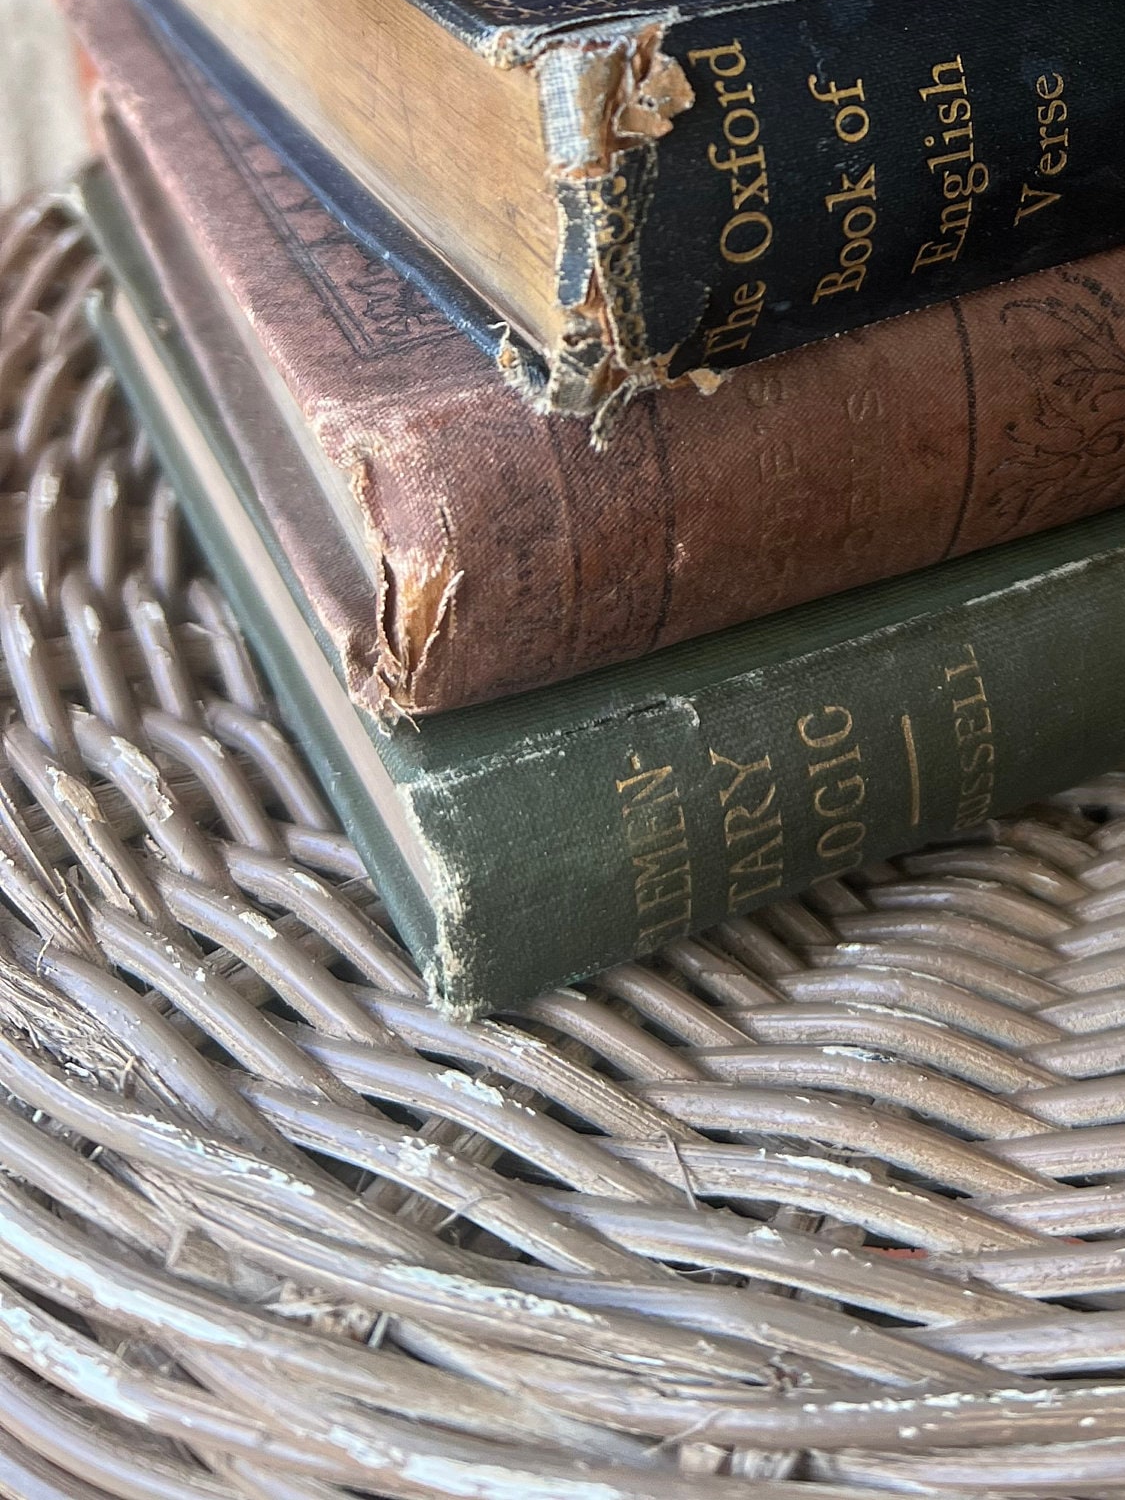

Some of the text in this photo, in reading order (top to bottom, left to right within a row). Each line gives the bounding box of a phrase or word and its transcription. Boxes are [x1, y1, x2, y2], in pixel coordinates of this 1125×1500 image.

[689, 37, 773, 263] Oxford
[809, 76, 879, 304] Book of
[912, 54, 989, 275] English
[1014, 72, 1069, 227] Verse
[709, 748, 783, 914] TARY
[797, 705, 868, 885] LOGIC
